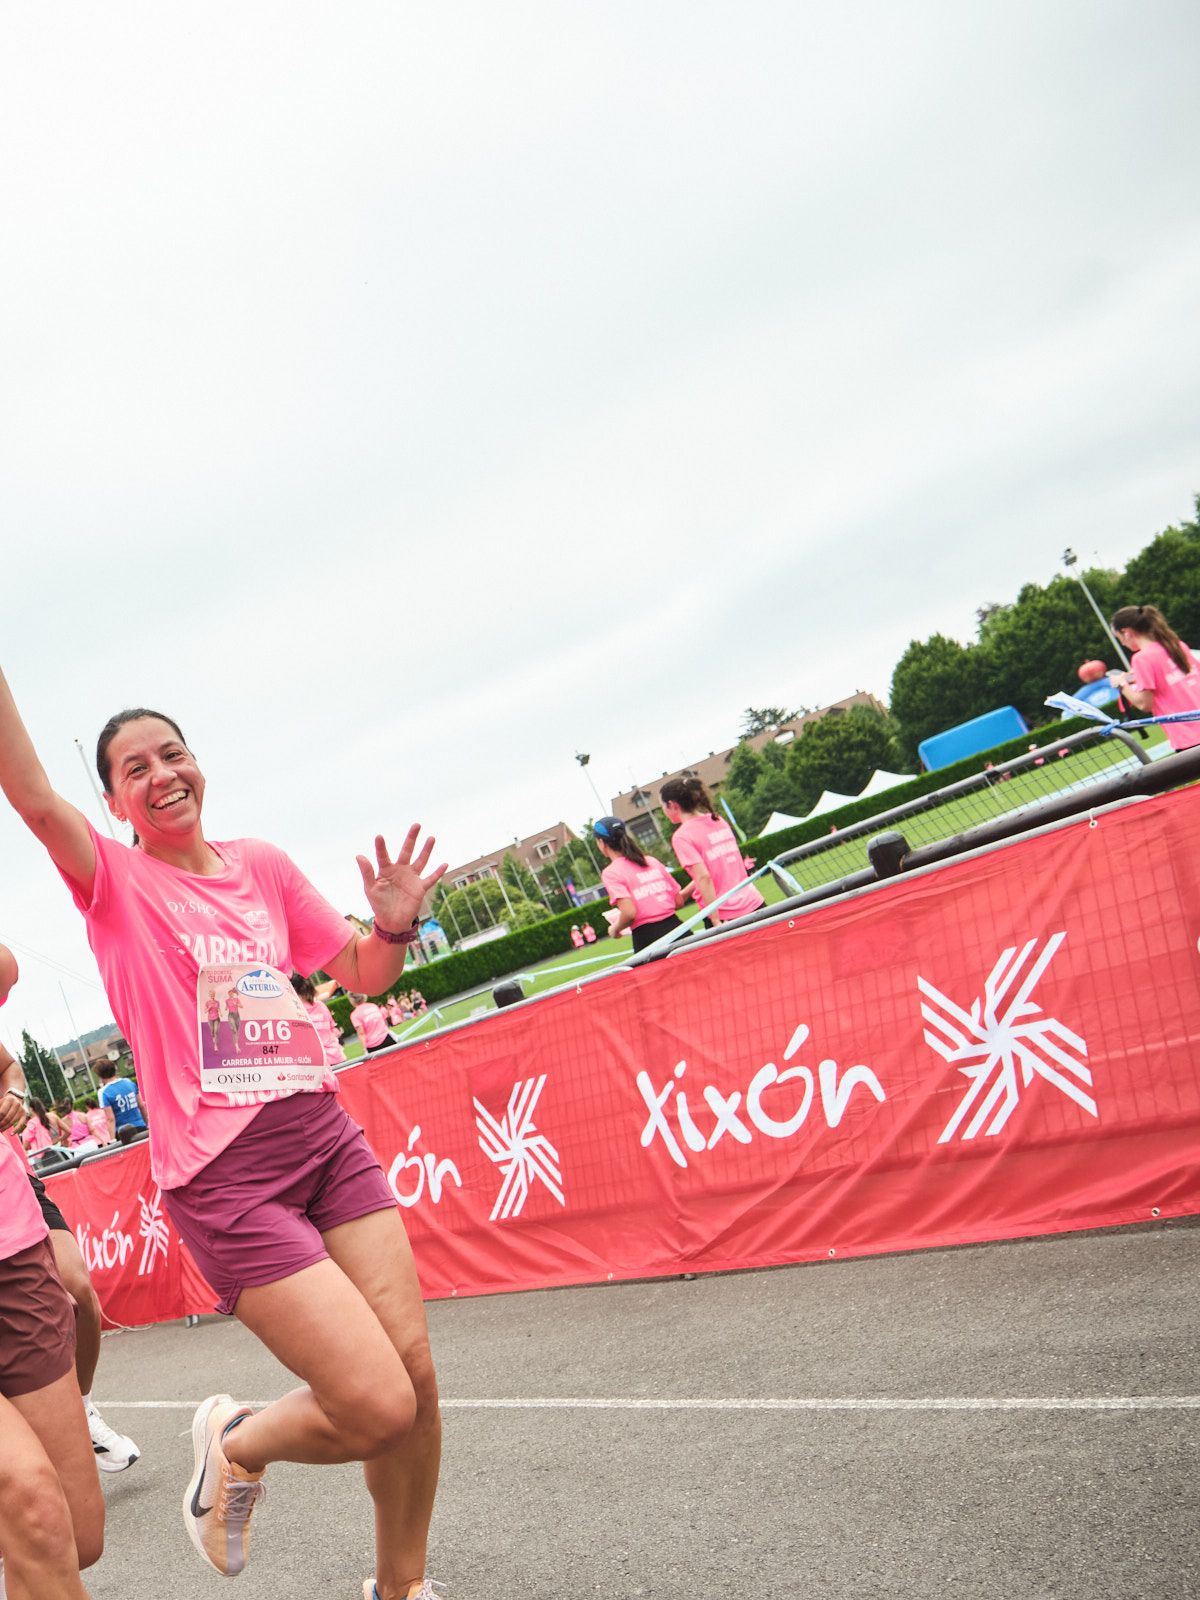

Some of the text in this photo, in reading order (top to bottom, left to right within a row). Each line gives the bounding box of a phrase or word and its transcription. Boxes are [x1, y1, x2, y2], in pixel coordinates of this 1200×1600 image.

[241, 981, 281, 992] ASTURIAN
[245, 1020, 291, 1042] 016
[262, 1045, 279, 1055] 847
[222, 1058, 253, 1067] CARRERA
[254, 1057, 263, 1065] DE
[264, 1057, 272, 1065] LA
[274, 1056, 294, 1065] MUJER
[217, 1072, 315, 1085] OYSHO Santander
[636, 1024, 886, 1169] xixón
